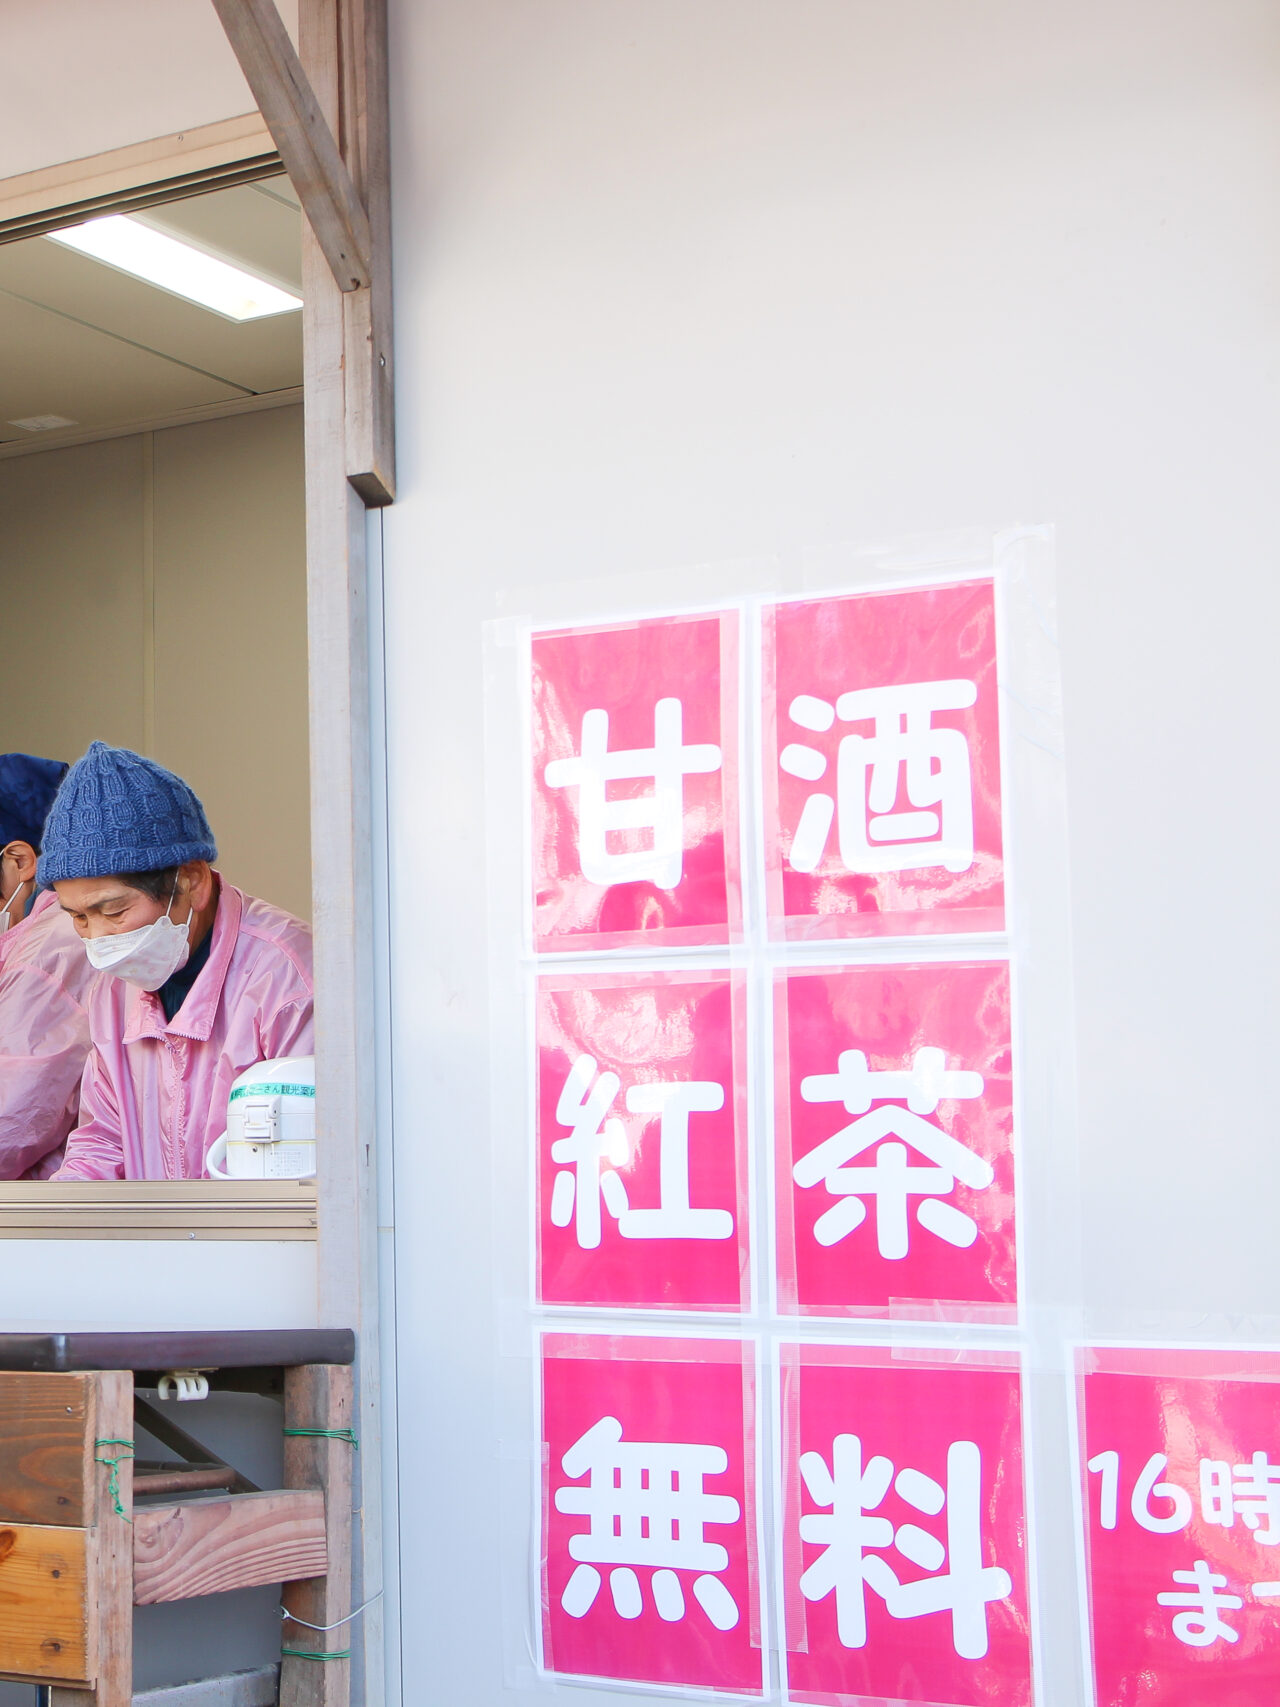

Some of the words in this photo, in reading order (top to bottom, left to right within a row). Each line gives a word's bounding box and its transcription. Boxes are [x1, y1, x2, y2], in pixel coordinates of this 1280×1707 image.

[545, 677, 978, 889] 甘酒
[551, 1048, 995, 1261] 紅茶
[554, 1415, 1013, 1661] 無料
[1087, 1450, 1280, 1546] 16時
[1157, 1560, 1280, 1648] ま
